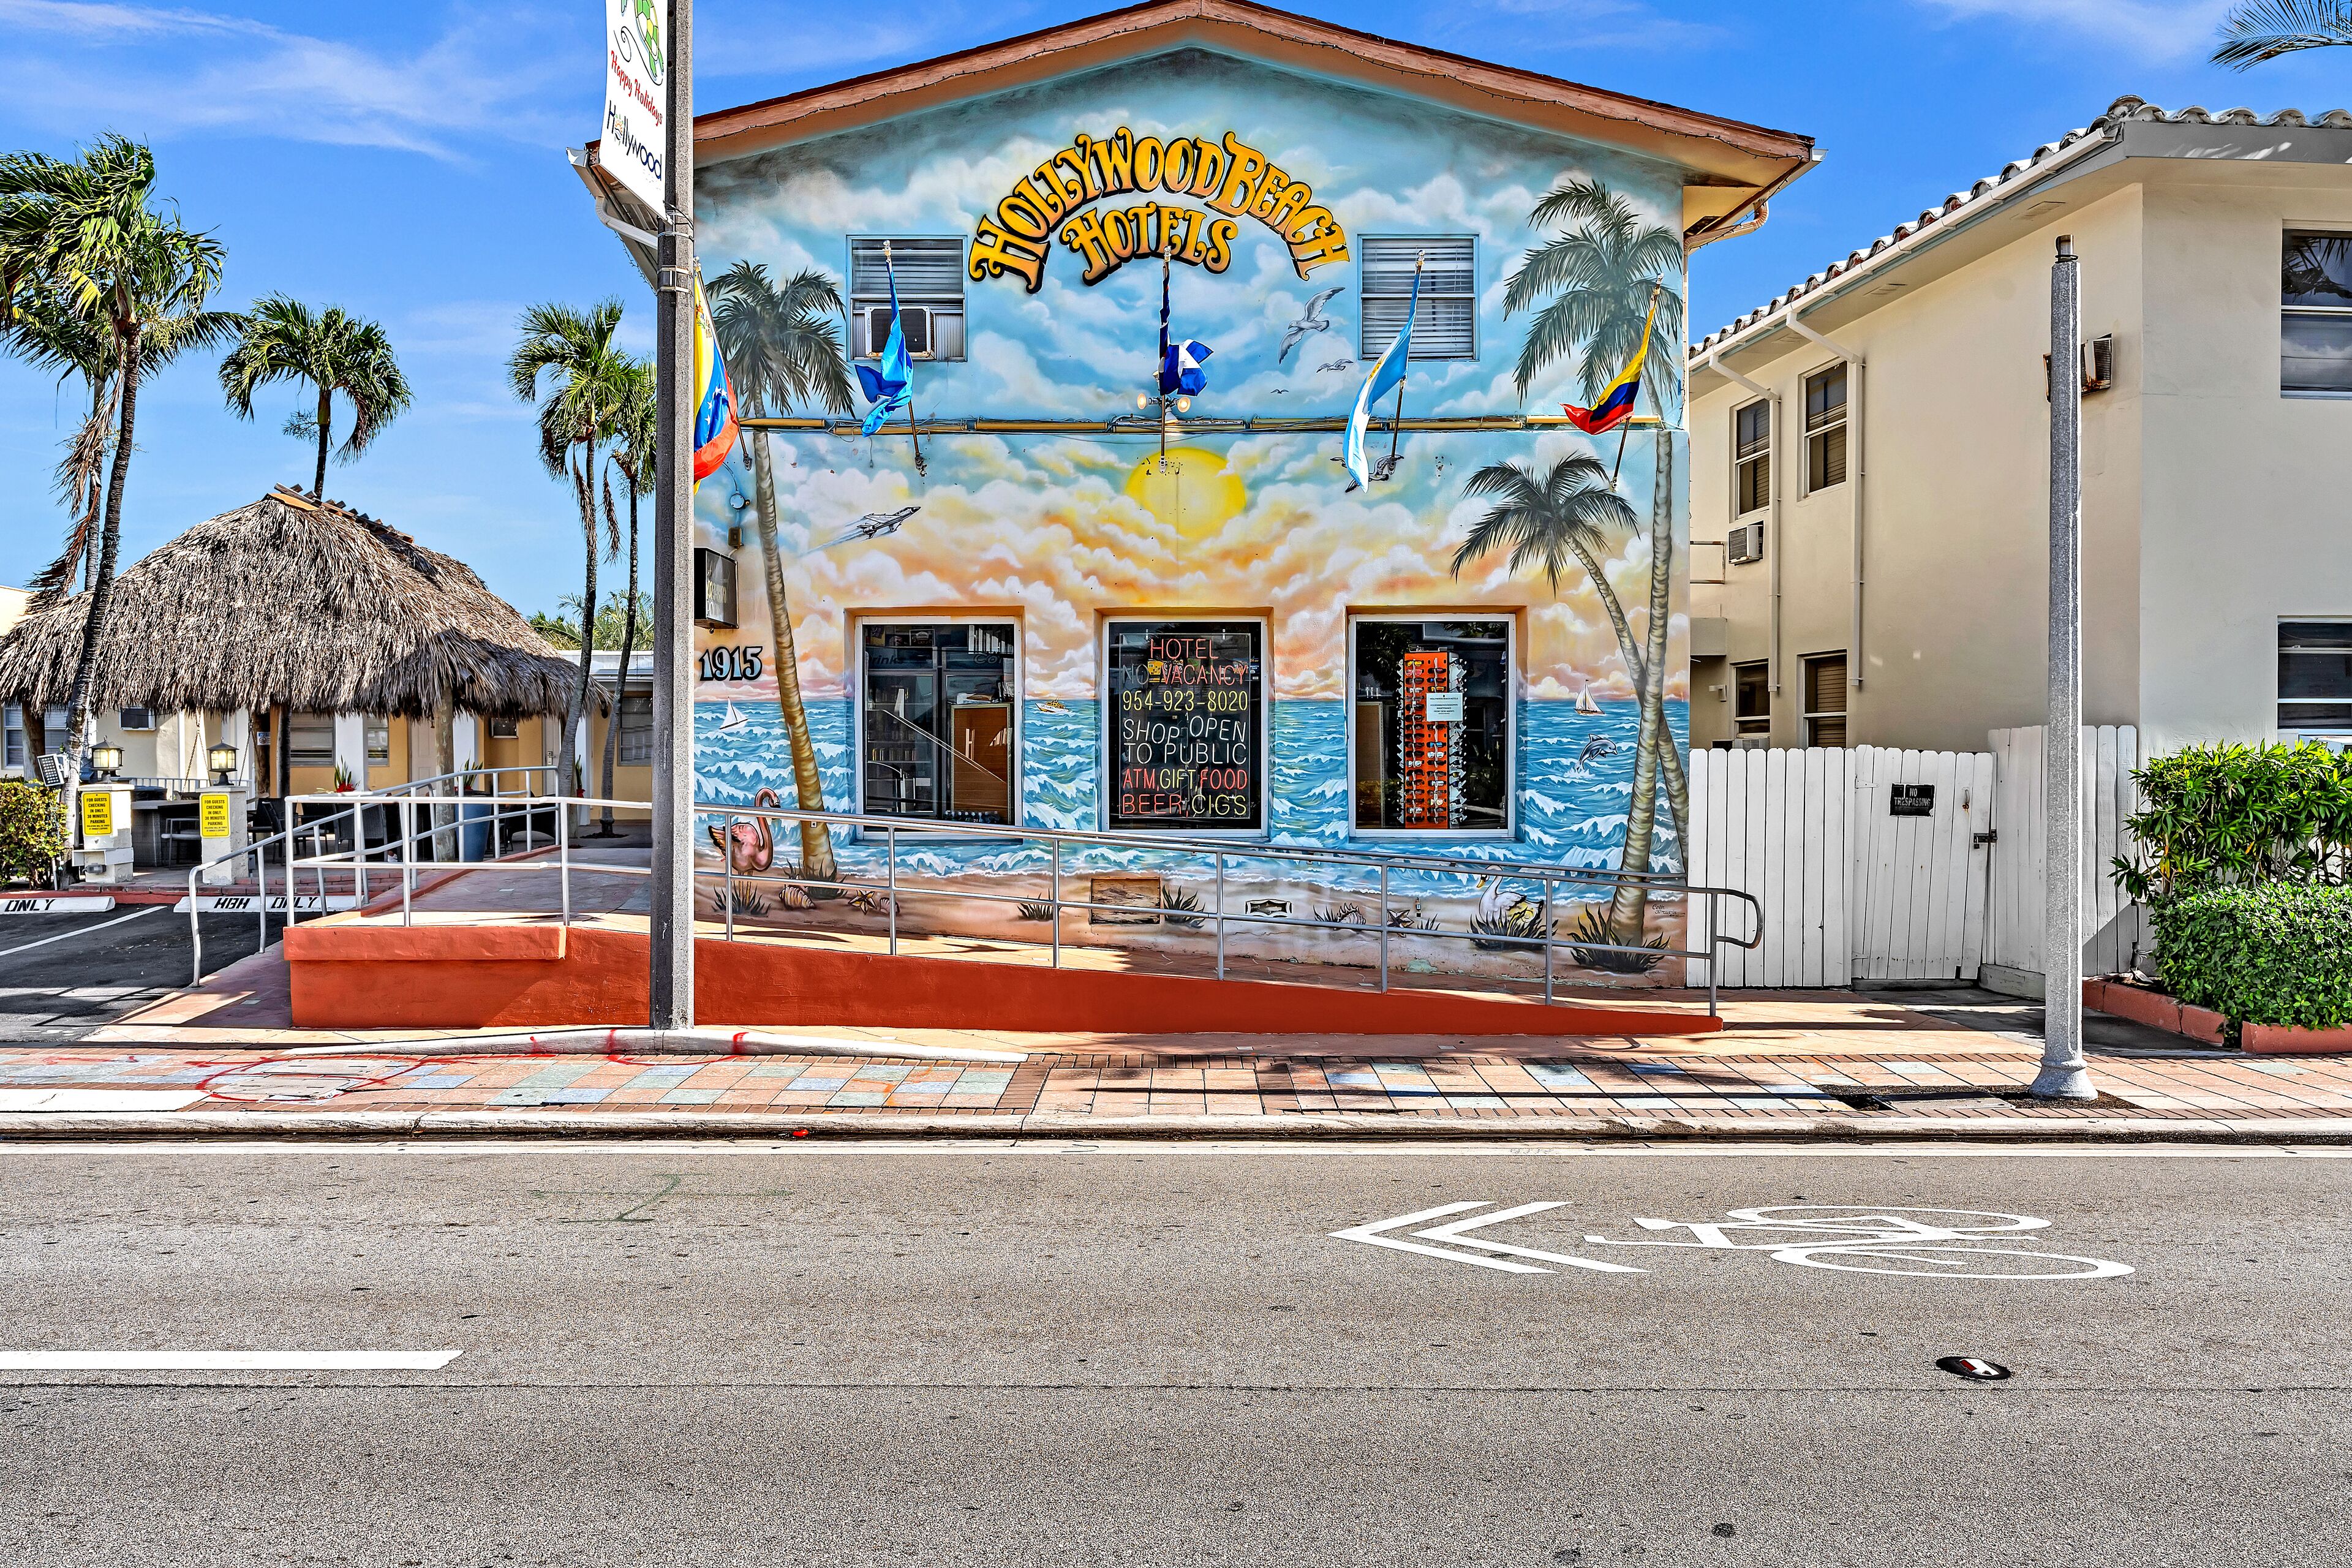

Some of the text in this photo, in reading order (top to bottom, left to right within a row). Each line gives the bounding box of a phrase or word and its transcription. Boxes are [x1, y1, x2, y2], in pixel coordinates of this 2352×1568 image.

[611, 50, 662, 126] Happy Holidays
[607, 100, 662, 181] Hollywood
[969, 126, 1350, 294] HOLLYWOOD BEACH
[1061, 202, 1238, 287] HOTELS
[1150, 638, 1219, 660] HOTEL
[699, 646, 763, 681] 1915
[1123, 663, 1249, 686] NO VACANCY
[1123, 690, 1248, 711] 954-923-8020
[1123, 716, 1246, 744] SHOP OPEN
[1123, 743, 1246, 764] TO PUBLIC
[1894, 797, 1931, 807] TRESPASSING
[1909, 788, 1918, 797] NO
[1192, 794, 1247, 816] CIGS
[4, 899, 56, 912] ONLY
[213, 897, 251, 909] HBH
